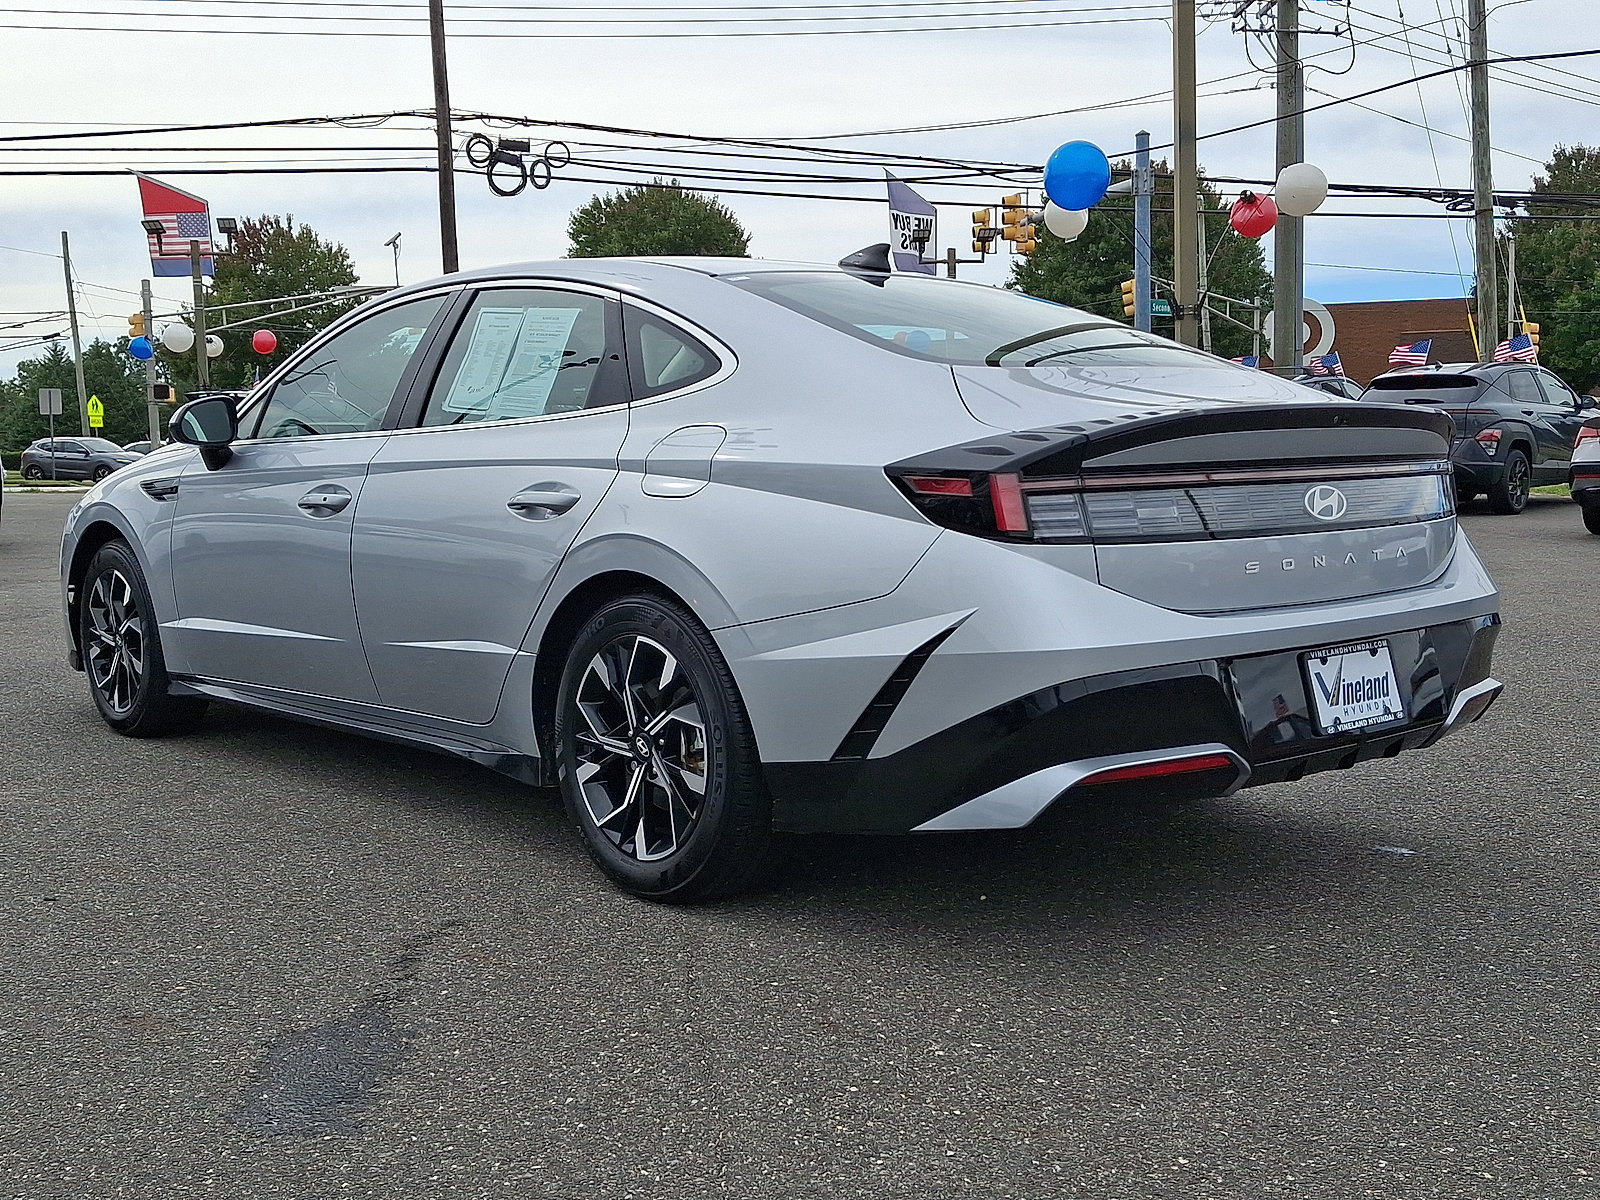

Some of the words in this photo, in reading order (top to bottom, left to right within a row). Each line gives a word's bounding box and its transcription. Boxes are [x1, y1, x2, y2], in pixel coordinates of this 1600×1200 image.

[1245, 546, 1407, 574] SONATA
[1310, 640, 1388, 659] VINELANDHYUNDAI.COM
[1314, 657, 1390, 707] Vineland
[1343, 699, 1393, 717] HYUNDAI
[1337, 717, 1367, 732] VINELAND
[1368, 713, 1395, 725] HYUNDAI
